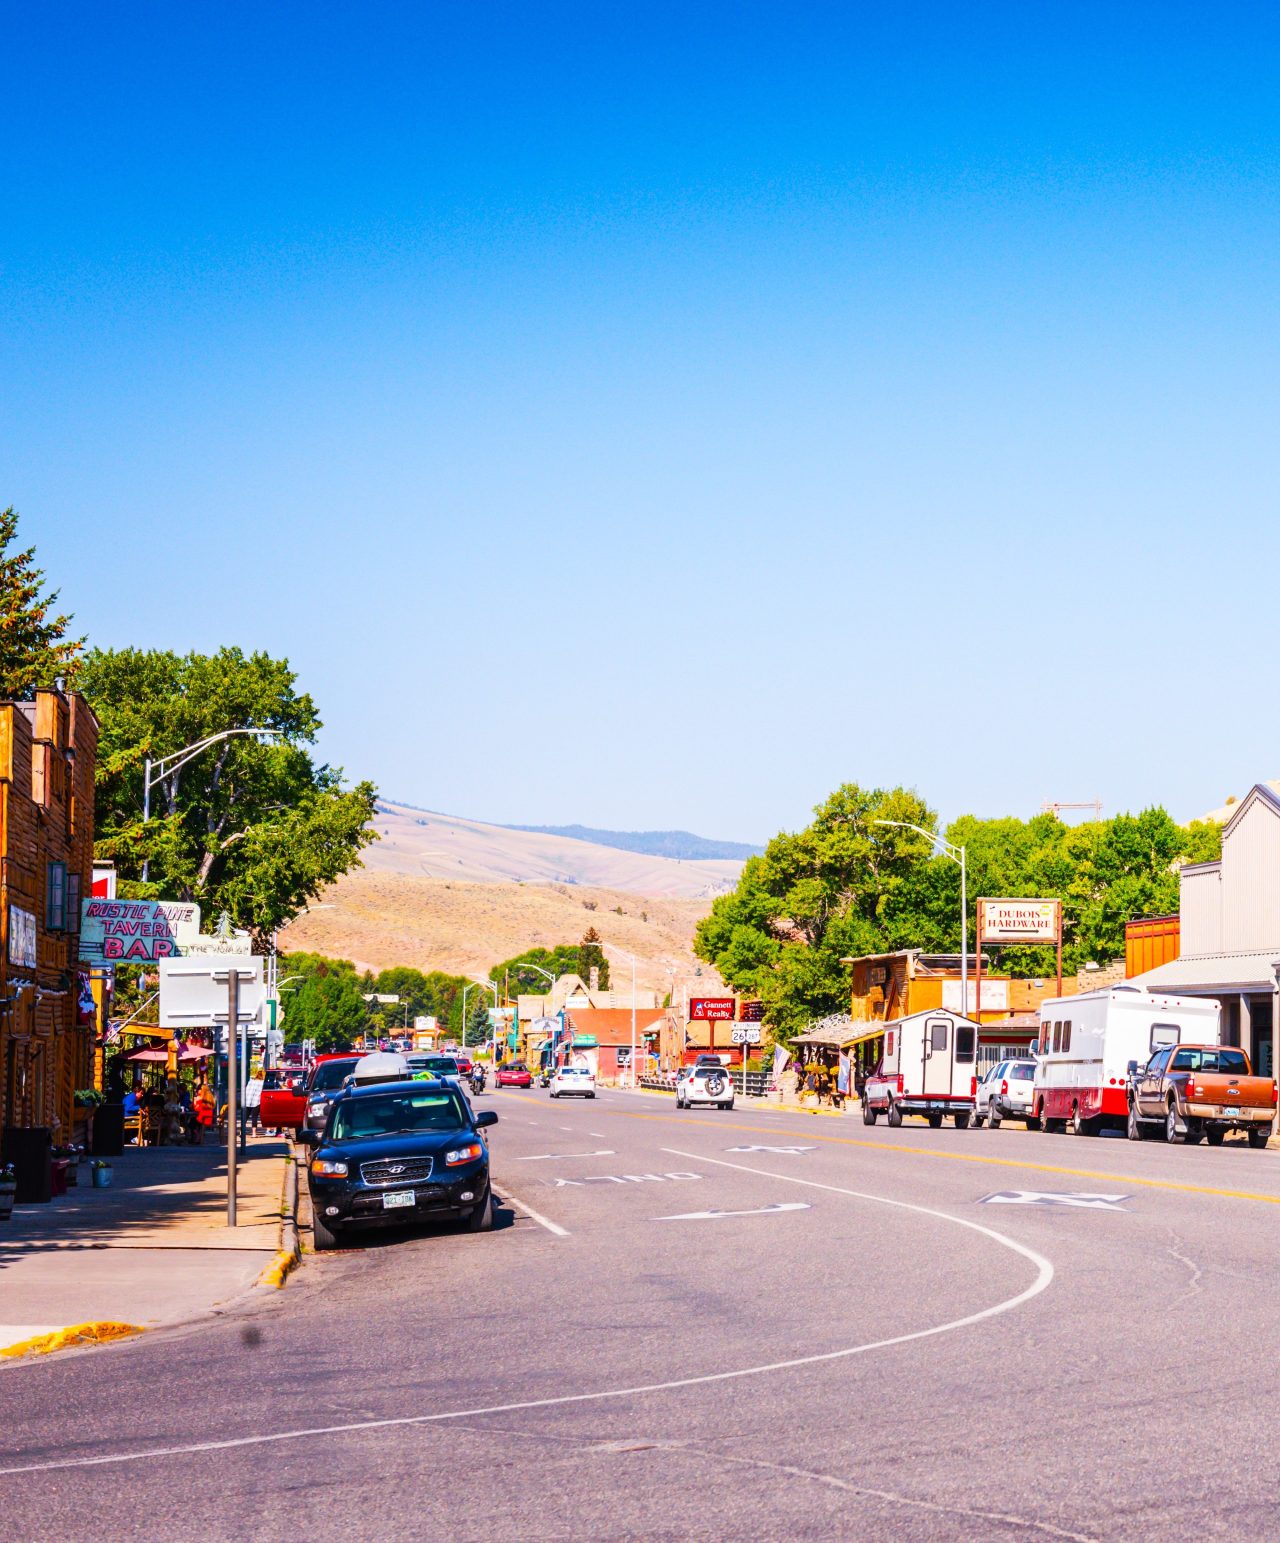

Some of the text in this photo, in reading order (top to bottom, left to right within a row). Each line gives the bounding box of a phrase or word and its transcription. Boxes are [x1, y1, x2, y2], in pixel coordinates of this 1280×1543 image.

[86, 902, 195, 922] RUSTIC PINE
[999, 910, 1041, 919] DUBOIS
[101, 919, 178, 938] TAVERN
[988, 919, 1051, 928] HARDWARE
[103, 937, 175, 961] BAR
[703, 1000, 732, 1009] Gannett
[733, 1032, 744, 1040] 26
[554, 1172, 703, 1187] ONLY
